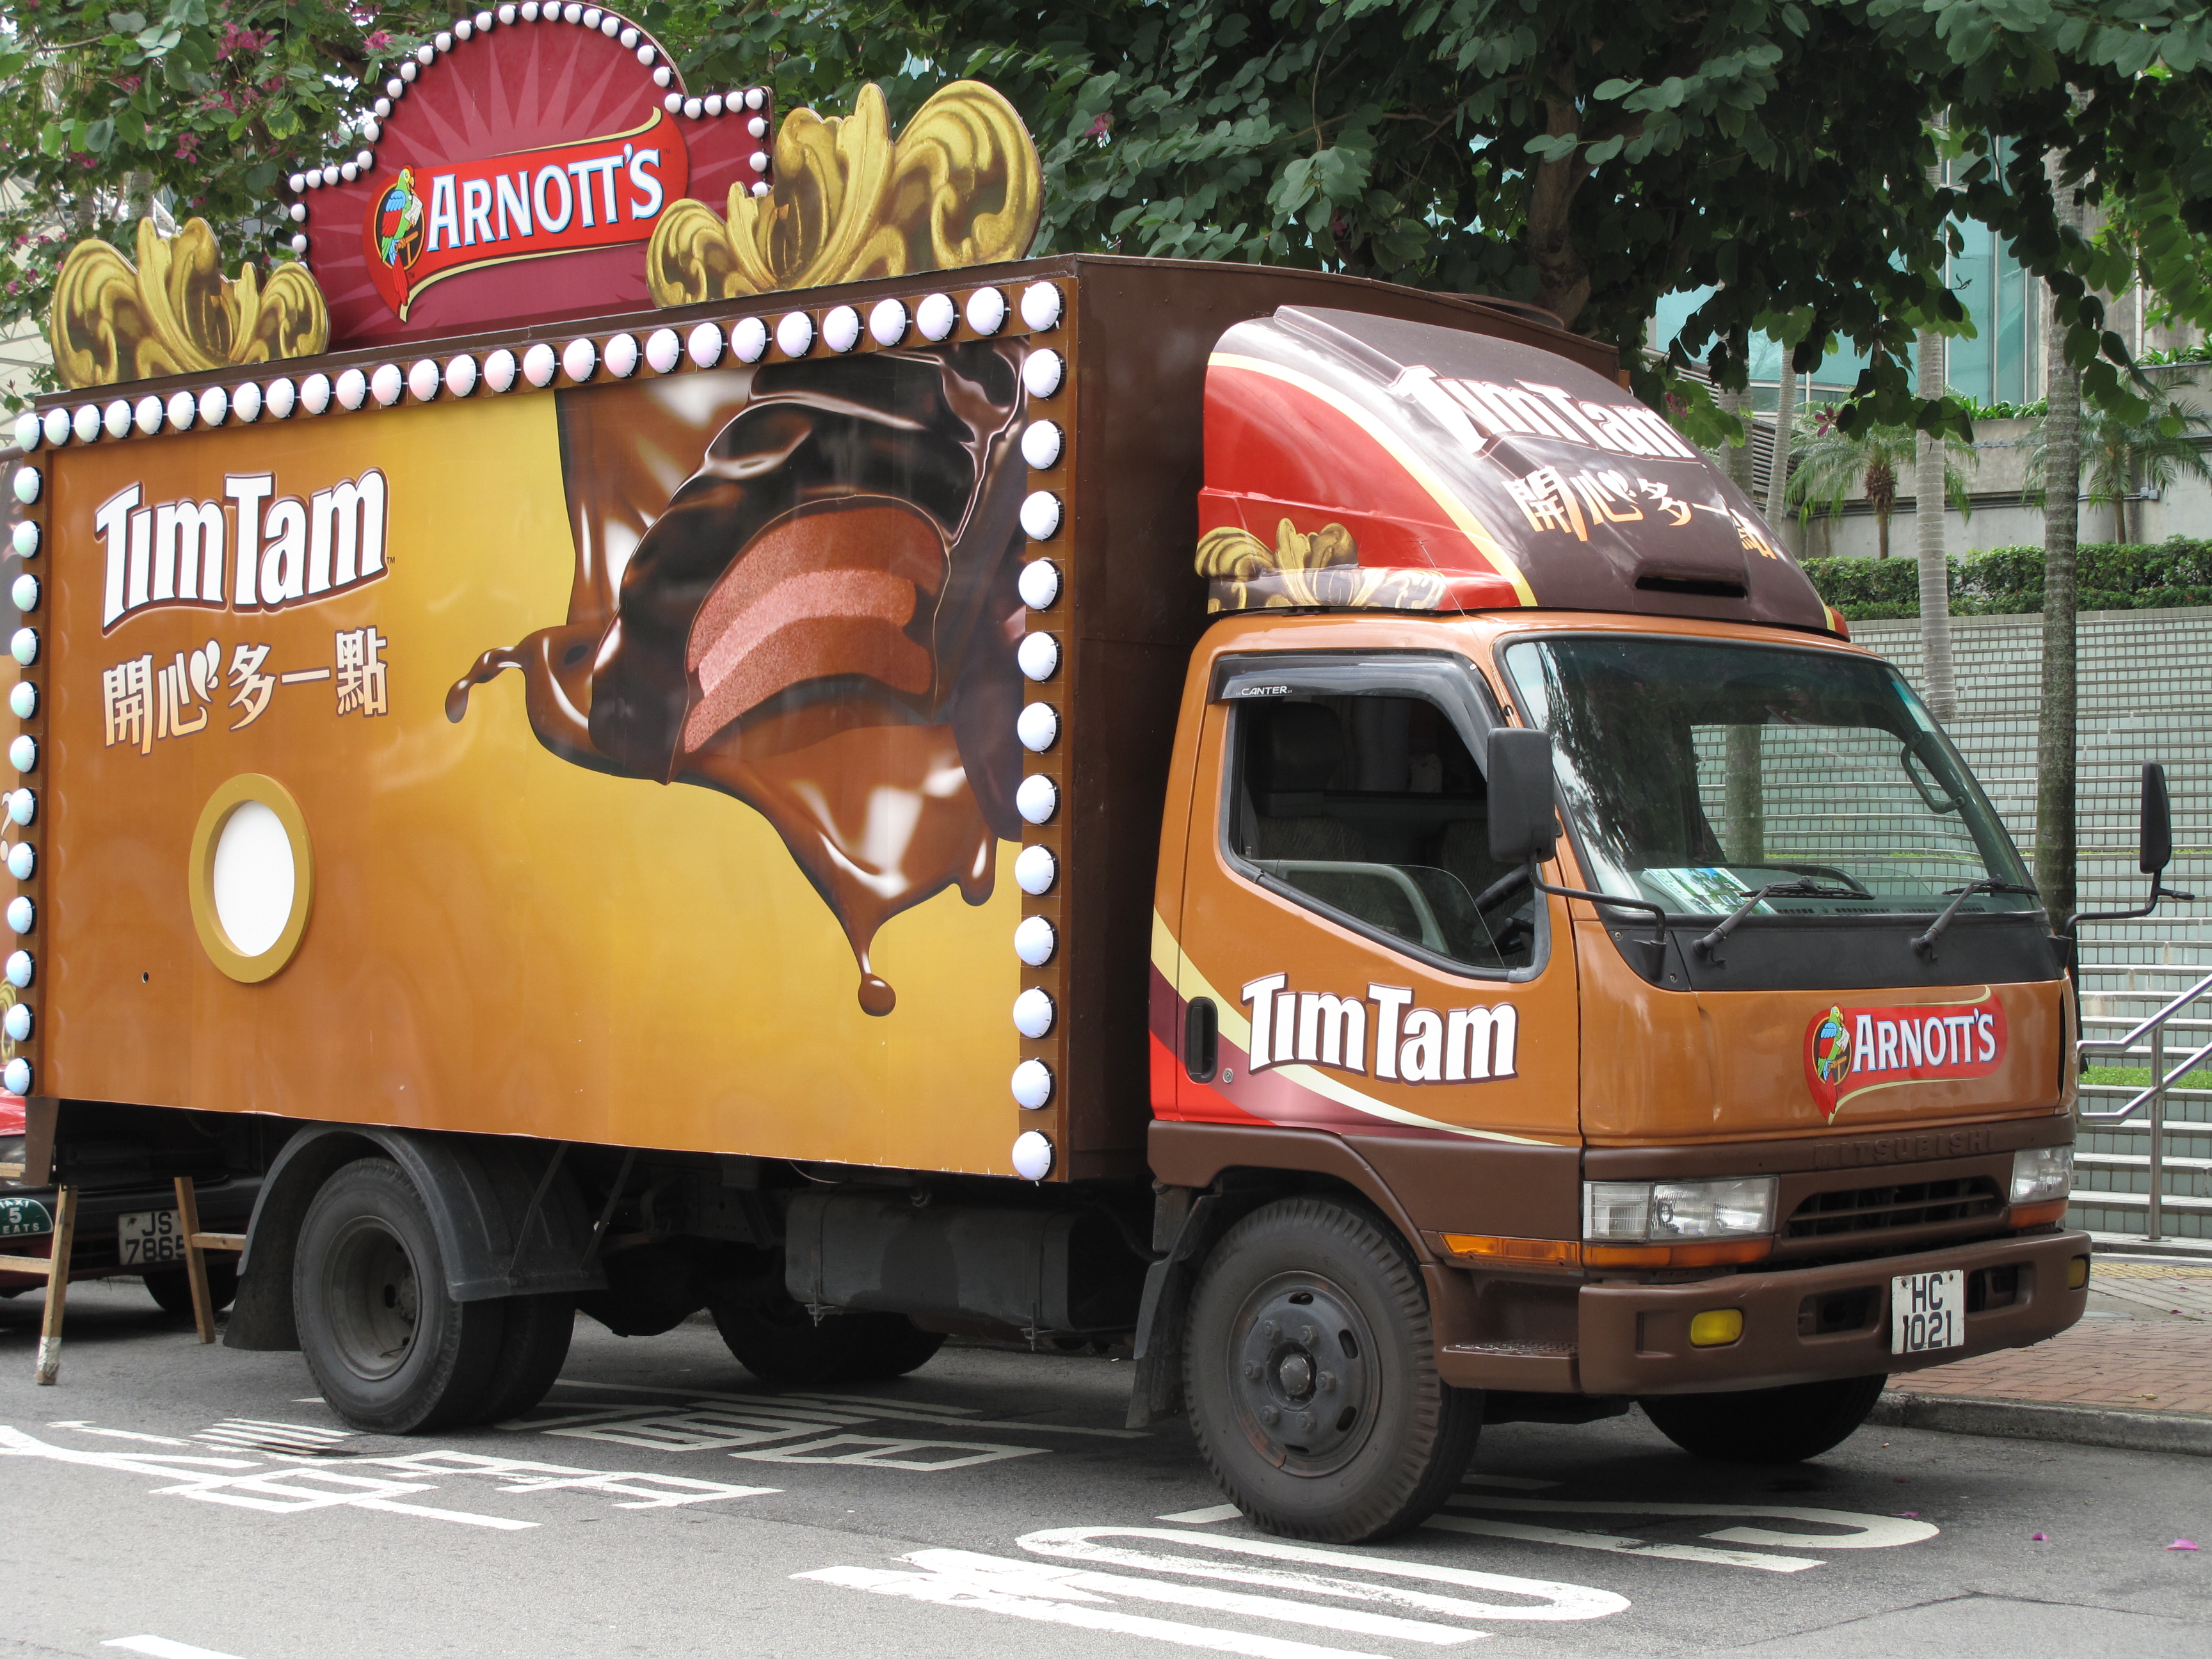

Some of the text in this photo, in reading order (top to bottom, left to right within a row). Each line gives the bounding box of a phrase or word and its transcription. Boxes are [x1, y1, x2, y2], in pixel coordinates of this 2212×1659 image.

[426, 142, 664, 252] ARNOTT'S
[102, 625, 388, 756] 開心多一點
[1241, 685, 1288, 696] CANTER
[1852, 1007, 1996, 1073] ARNOTT'S
[1813, 1129, 1993, 1169] MITSUBISHI
[0, 1222, 40, 1234] EATS
[9, 1206, 22, 1223] 5
[141, 1211, 172, 1237] JS
[125, 1235, 187, 1265] 7865
[1912, 1273, 1943, 1313] HC
[1902, 1310, 1952, 1354] 1021
